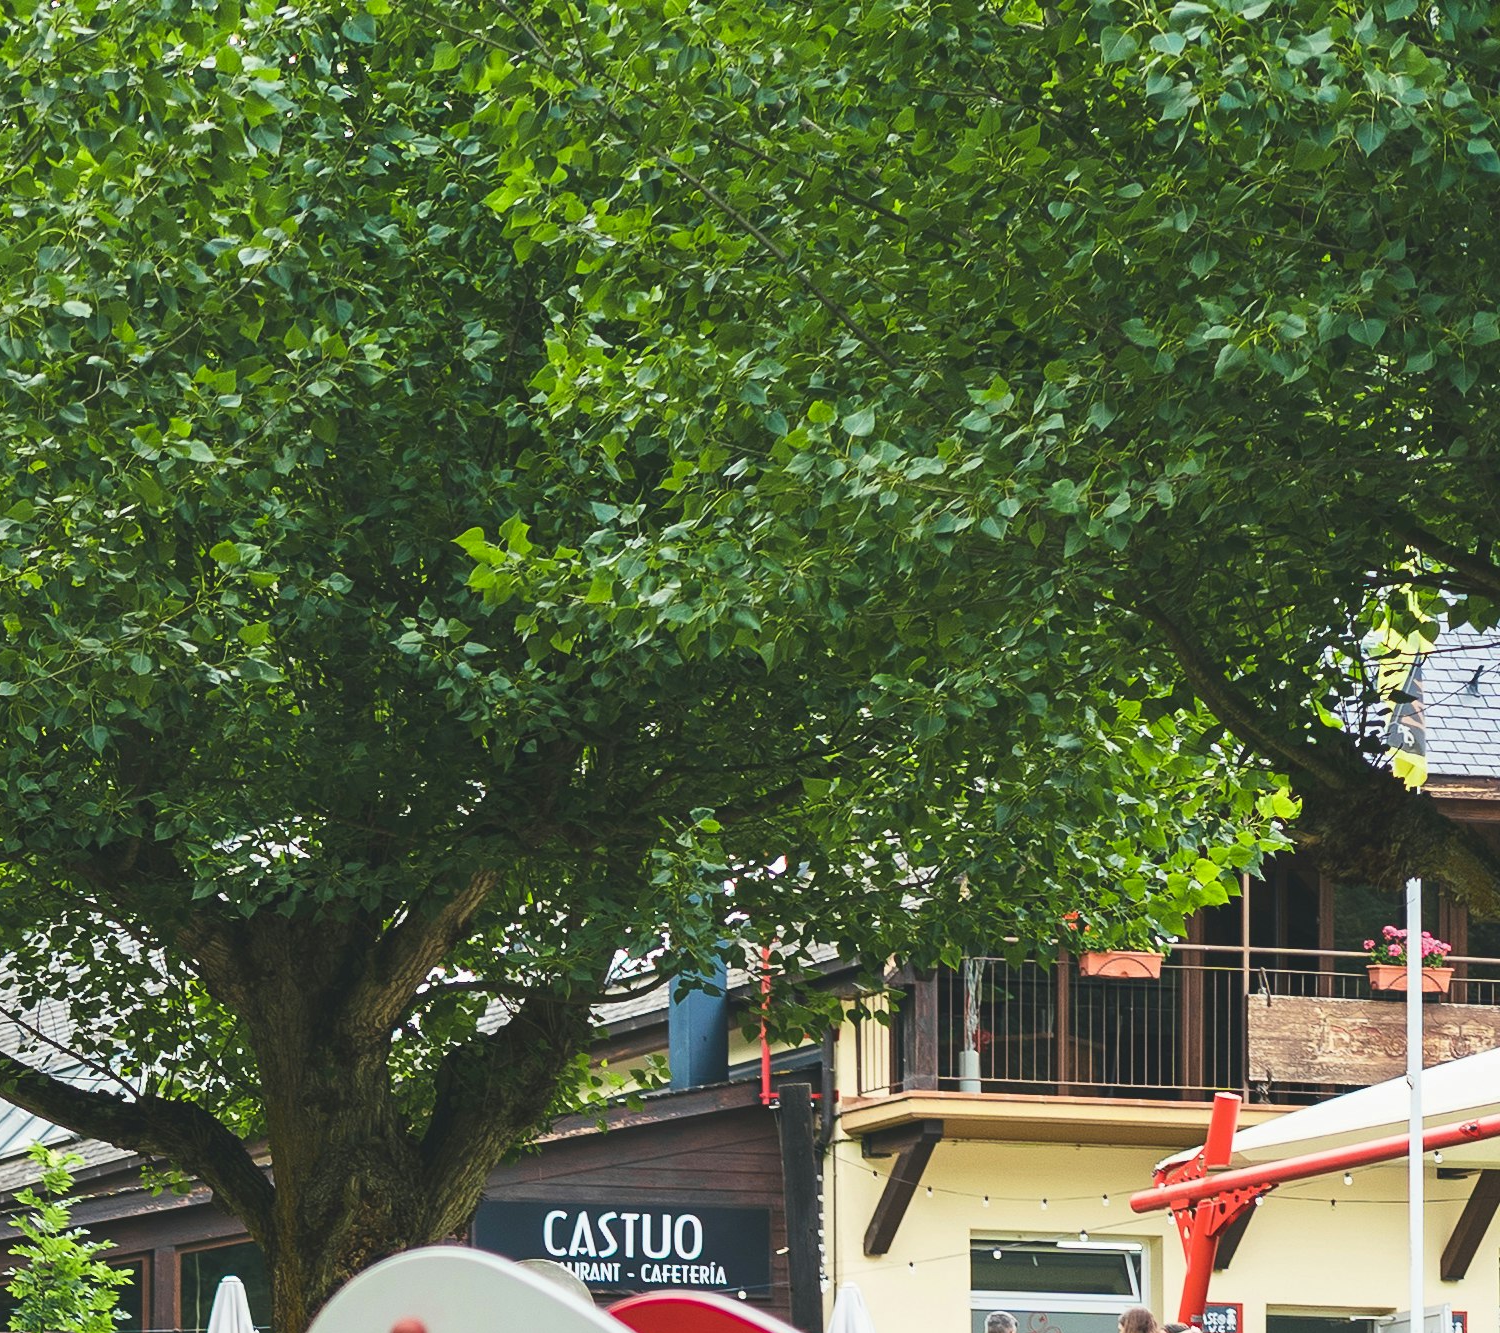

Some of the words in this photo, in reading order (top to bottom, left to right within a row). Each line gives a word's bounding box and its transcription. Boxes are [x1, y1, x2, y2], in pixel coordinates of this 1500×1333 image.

[543, 1210, 703, 1261] CASTUO
[560, 1262, 621, 1283] URANT
[640, 1261, 728, 1285] CAFETERÍA
